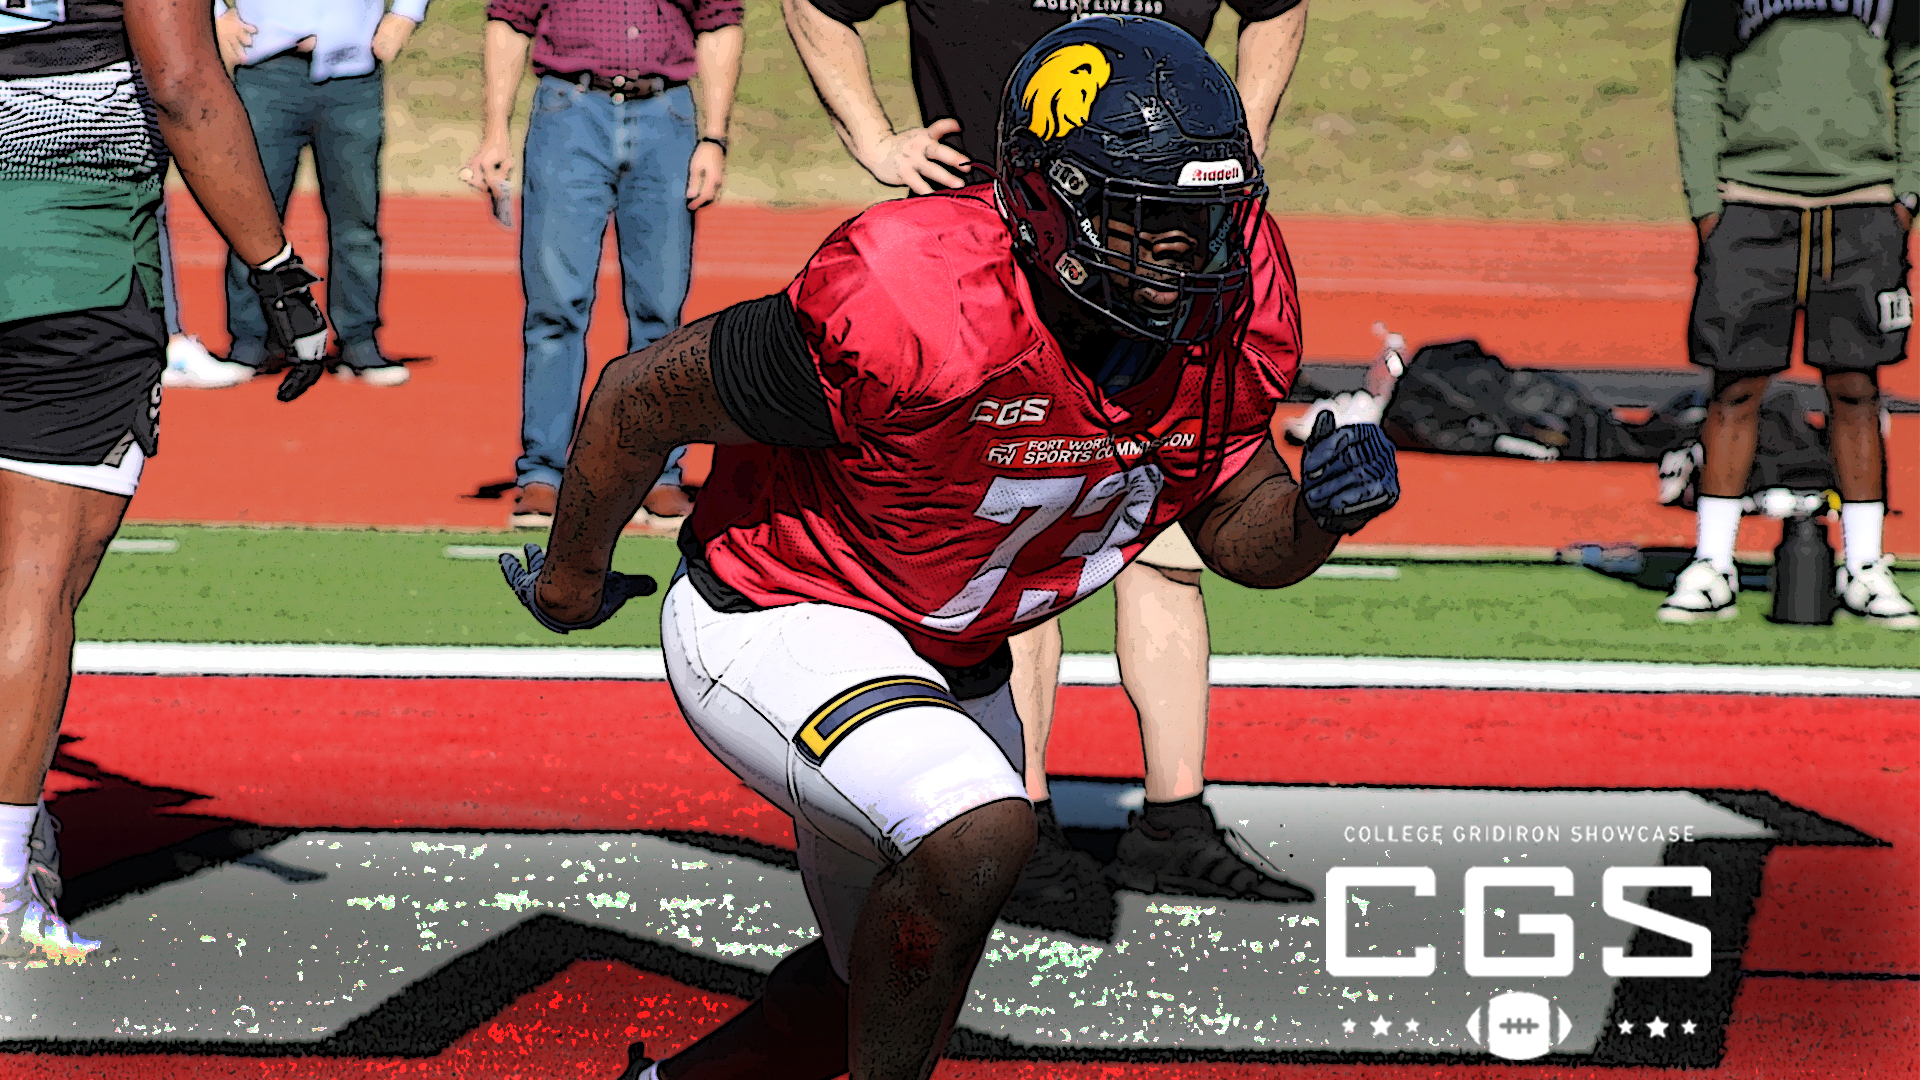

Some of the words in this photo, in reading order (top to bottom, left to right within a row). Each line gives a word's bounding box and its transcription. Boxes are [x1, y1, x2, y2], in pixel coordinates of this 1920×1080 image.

[1094, 0, 1130, 13] LIVE
[1134, 0, 1163, 14] 360
[1192, 166, 1239, 181] Riddell
[970, 398, 1050, 426] CGS
[1028, 439, 1066, 452] FORT
[1022, 450, 1092, 465] SPORTS
[920, 464, 1164, 632] 73
